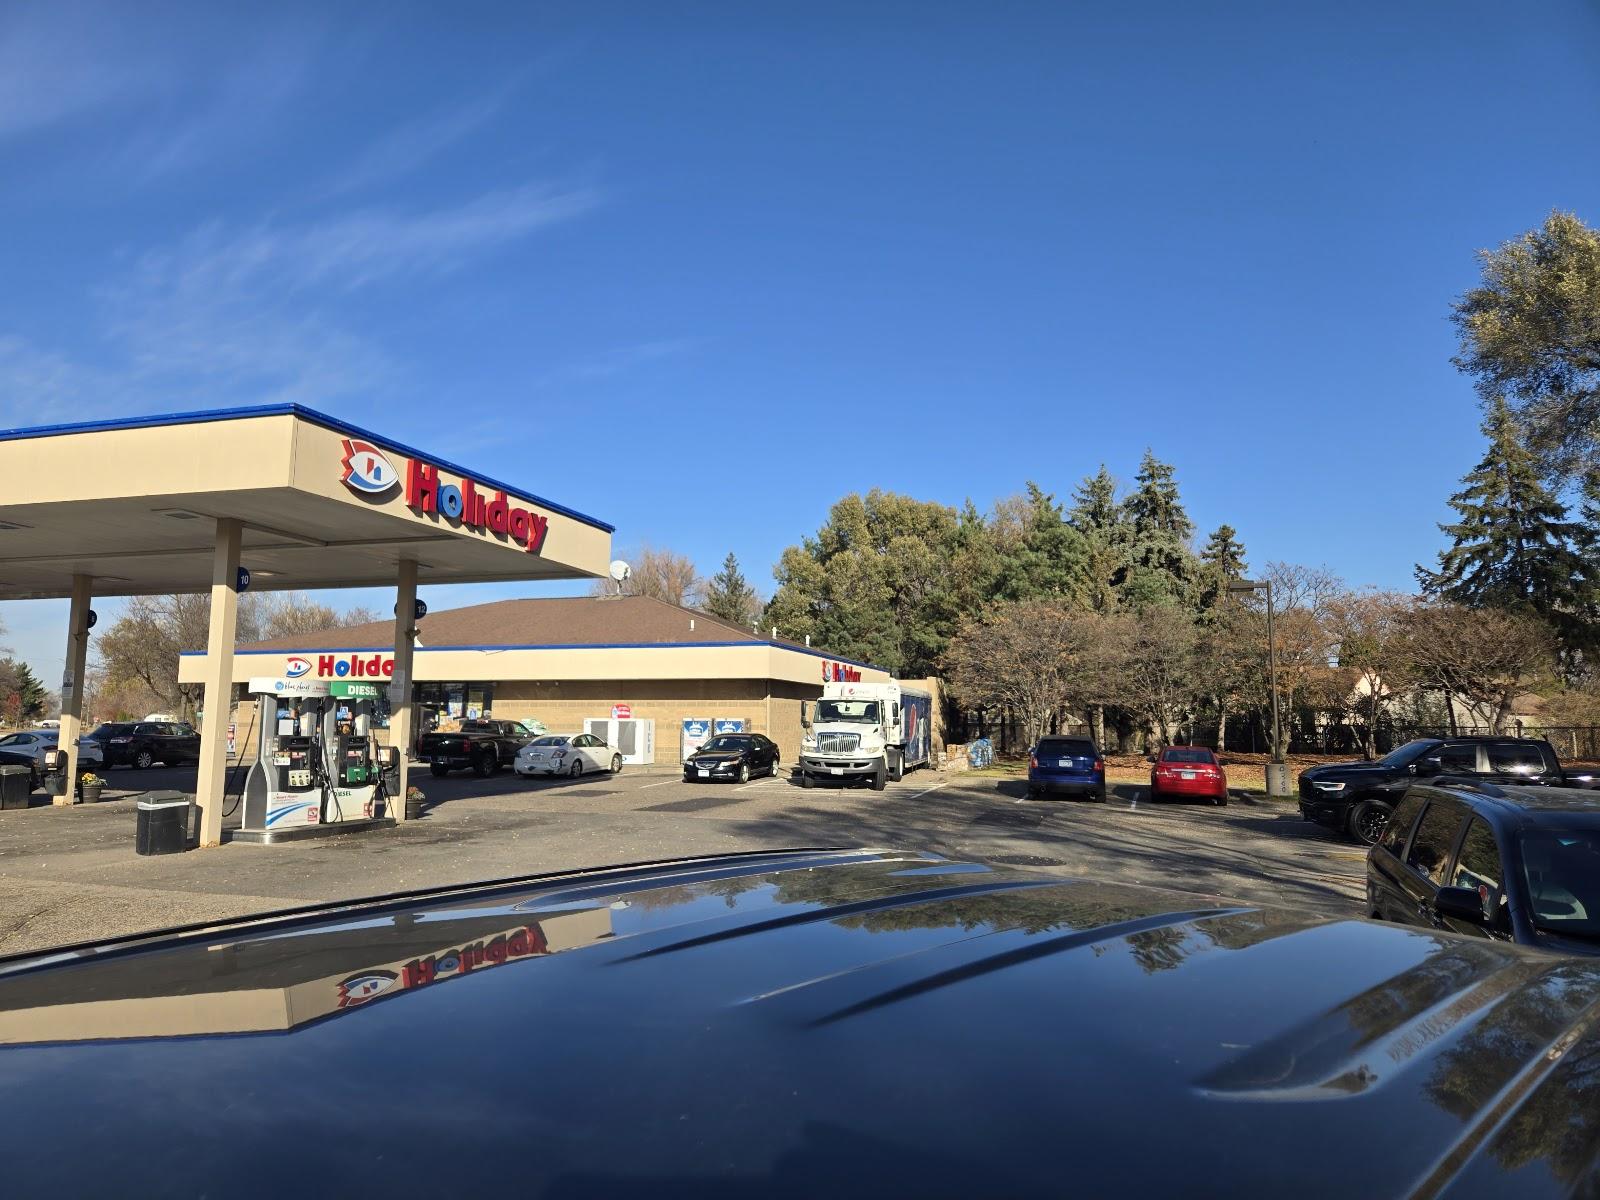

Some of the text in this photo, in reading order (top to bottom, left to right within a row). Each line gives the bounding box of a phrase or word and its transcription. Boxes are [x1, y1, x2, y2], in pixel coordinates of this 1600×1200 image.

[405, 457, 548, 552] Holiday
[240, 575, 249, 585] 10
[417, 605, 426, 614] 12
[317, 654, 396, 677] Holida
[347, 684, 378, 696] DIESEL
